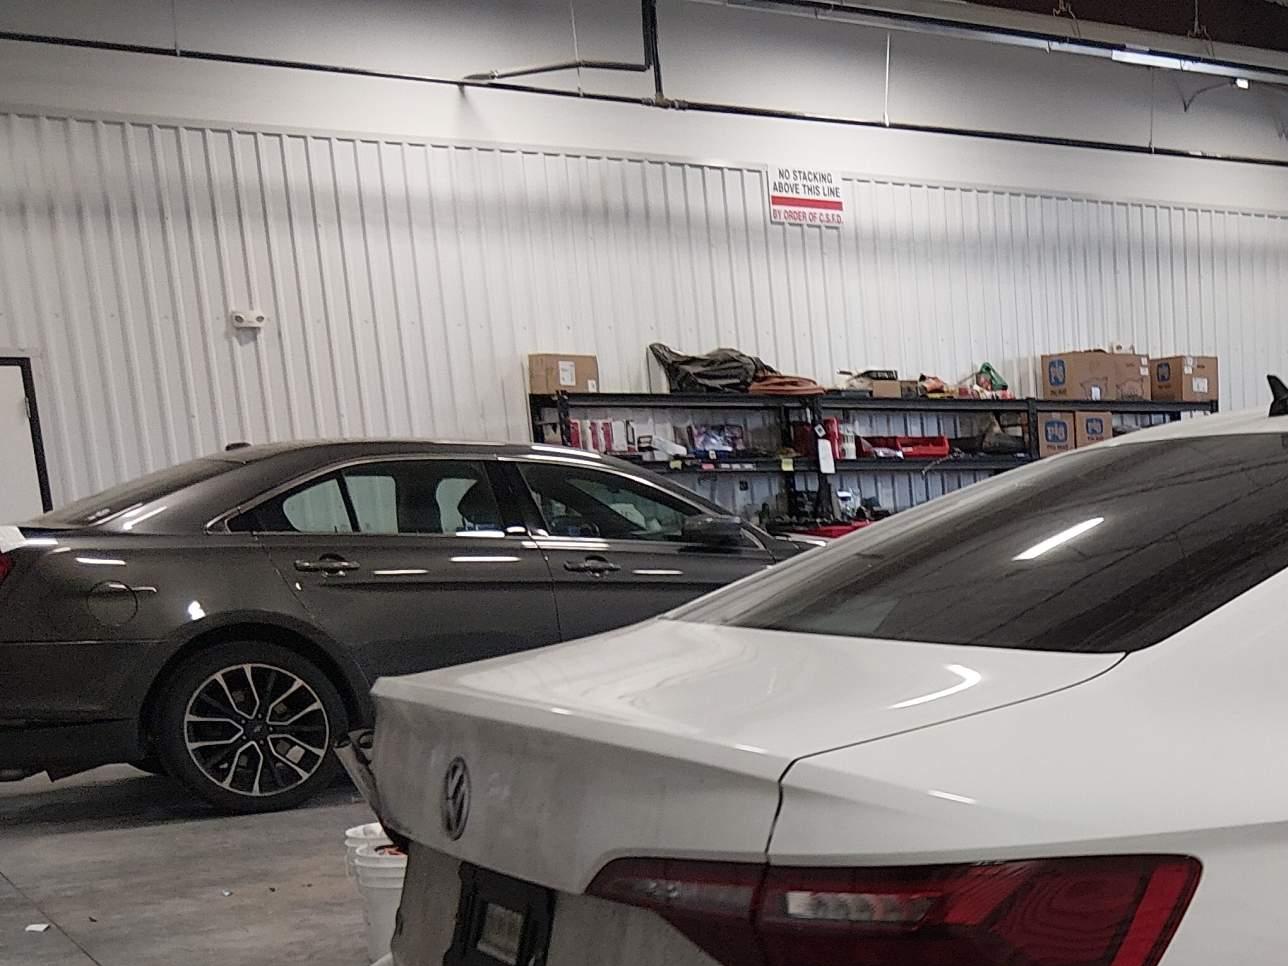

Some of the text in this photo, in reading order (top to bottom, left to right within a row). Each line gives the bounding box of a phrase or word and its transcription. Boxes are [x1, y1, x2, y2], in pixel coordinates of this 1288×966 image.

[778, 169, 833, 184] NO STACKING
[773, 182, 841, 198] ABOVE THIS LINE
[772, 209, 782, 220] BY
[784, 210, 807, 222] ORDER
[809, 212, 818, 223] OF
